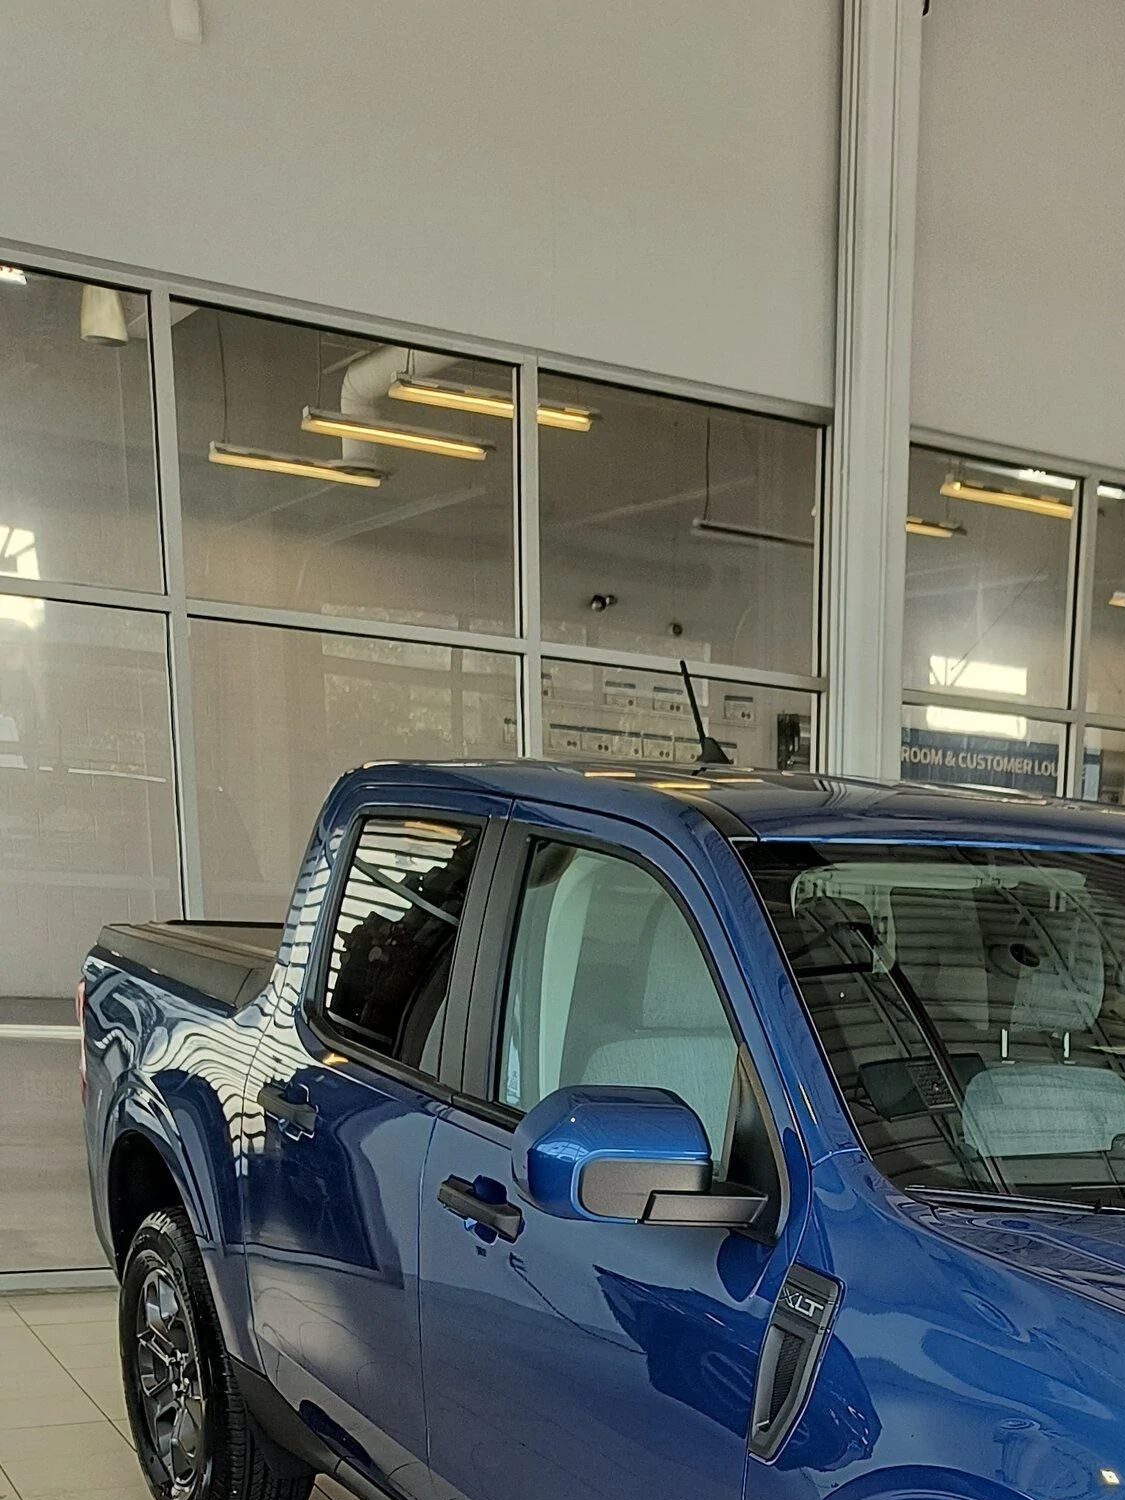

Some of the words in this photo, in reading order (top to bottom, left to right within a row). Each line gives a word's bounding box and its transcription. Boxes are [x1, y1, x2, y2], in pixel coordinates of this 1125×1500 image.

[901, 745, 943, 766] ROOM
[944, 750, 956, 767] &
[957, 752, 1033, 775] CUSTOMER
[779, 1286, 825, 1317] XLT
